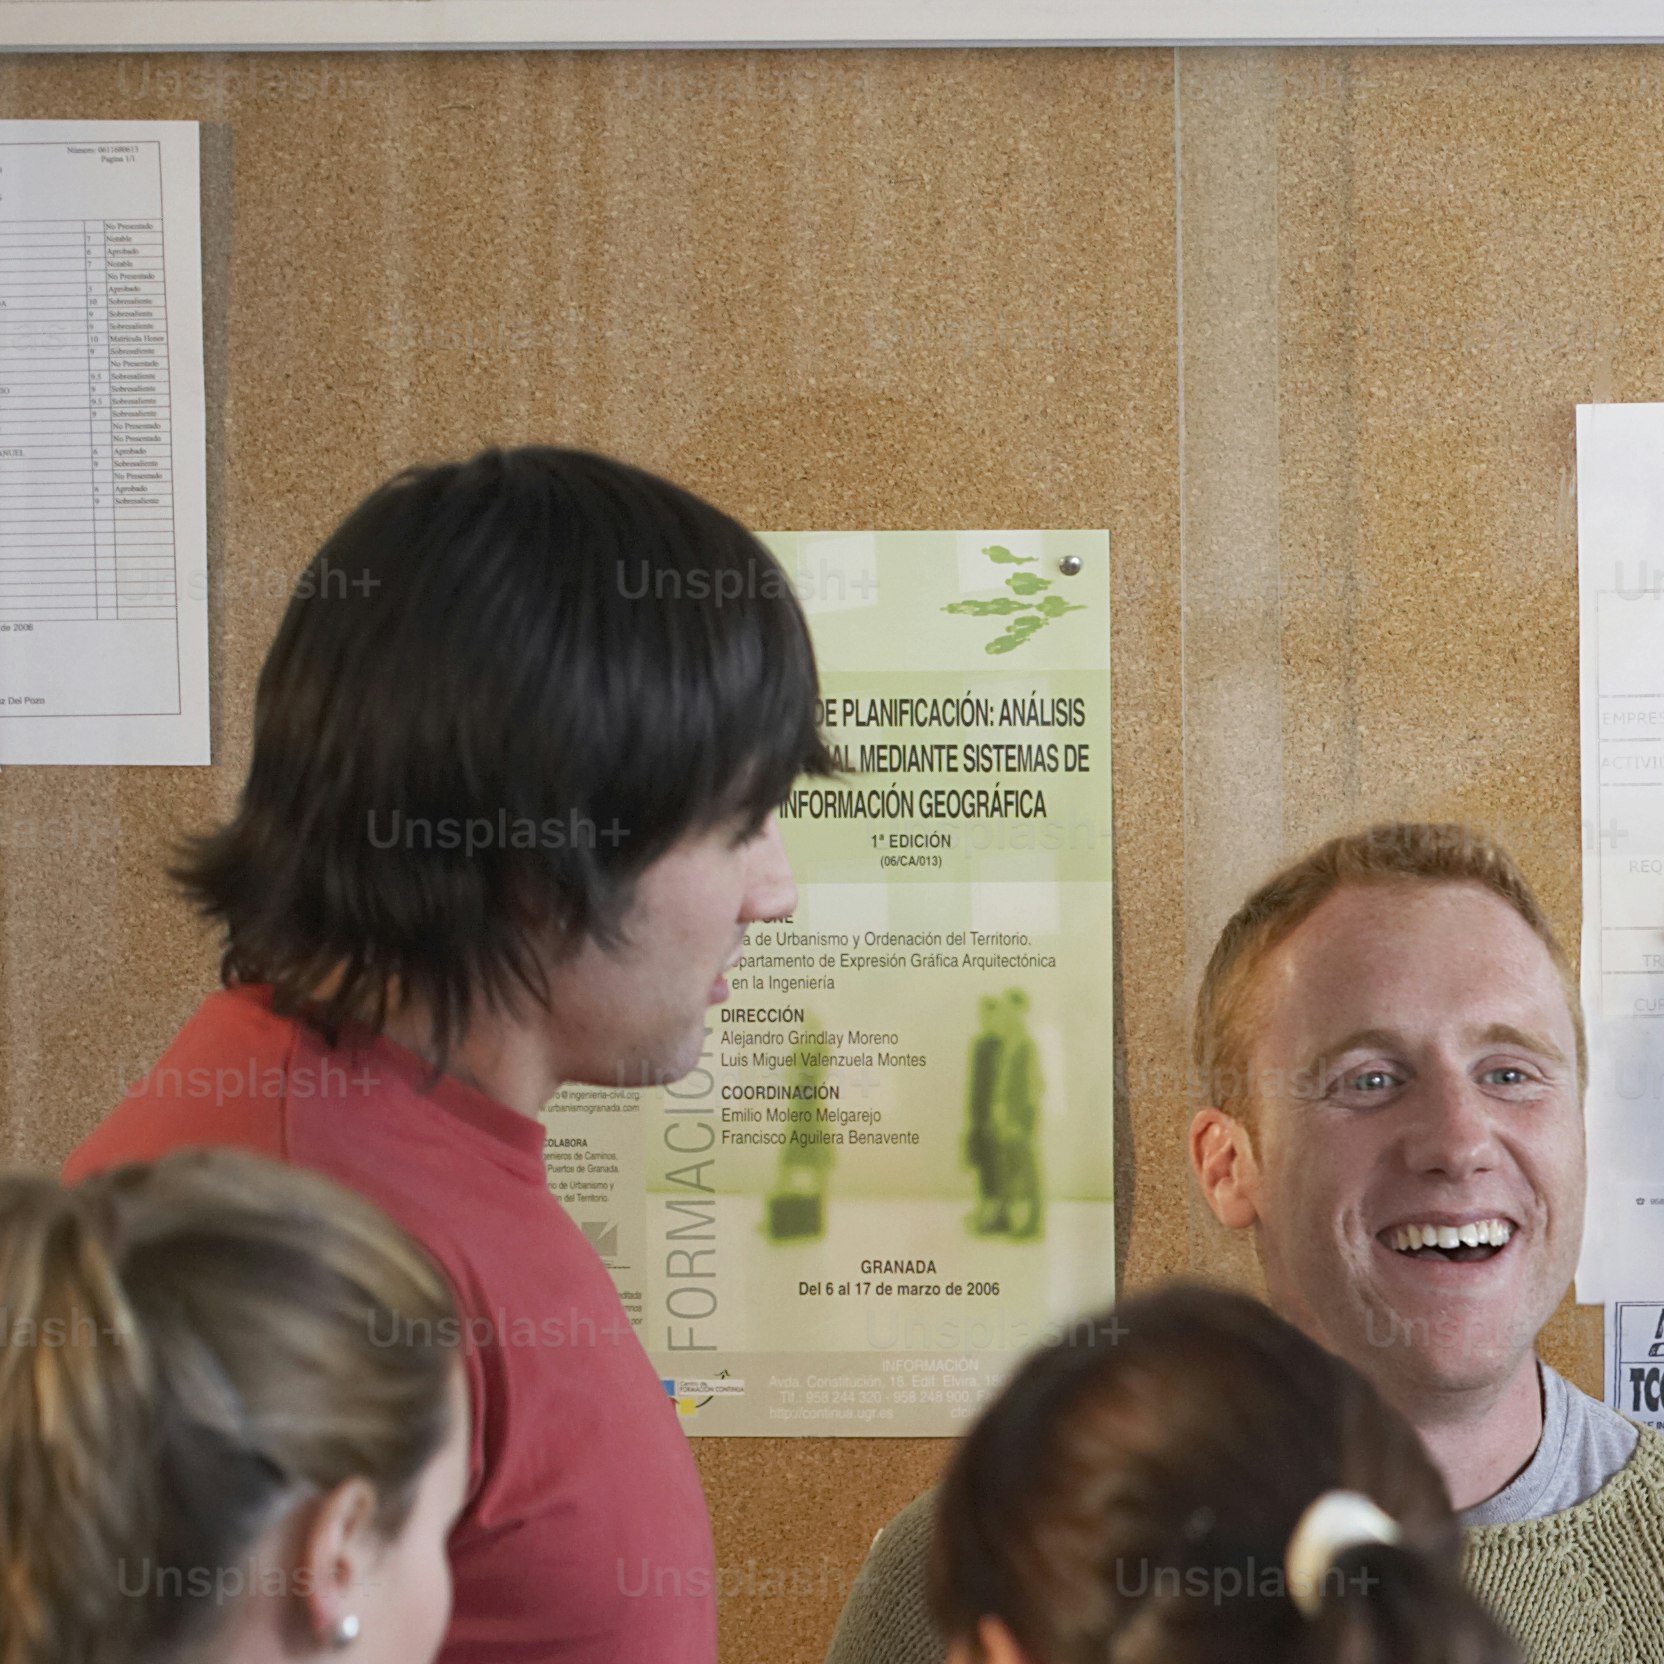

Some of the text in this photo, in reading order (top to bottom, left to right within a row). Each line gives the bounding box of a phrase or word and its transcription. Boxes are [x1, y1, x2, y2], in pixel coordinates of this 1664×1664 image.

[842, 691, 994, 728] PLANIFICACIÓN:
[998, 690, 1086, 728] ANÁLISIS
[860, 743, 1090, 774] MEDIANTE SISTEMAS DE
[919, 781, 1048, 820] GEOGRÁFICA
[888, 830, 951, 849] EDICIÓN
[880, 854, 943, 869] (06/CA/013)
[721, 1005, 805, 1024] DIRECCIÓN
[721, 1029, 899, 1049] Alejandro Grindlay Moreno
[721, 1052, 927, 1071] Luis Miguel Valenzuela Montes
[722, 1082, 840, 1101] COORDINACIÓN
[722, 1106, 882, 1127] Emilio Molero Melgarejo
[722, 1129, 920, 1149] Francisco Aguilera Benavente
[860, 1259, 937, 1275] GRANADA
[798, 1281, 1000, 1296] Del 6 al 17 de marzo de 2006
